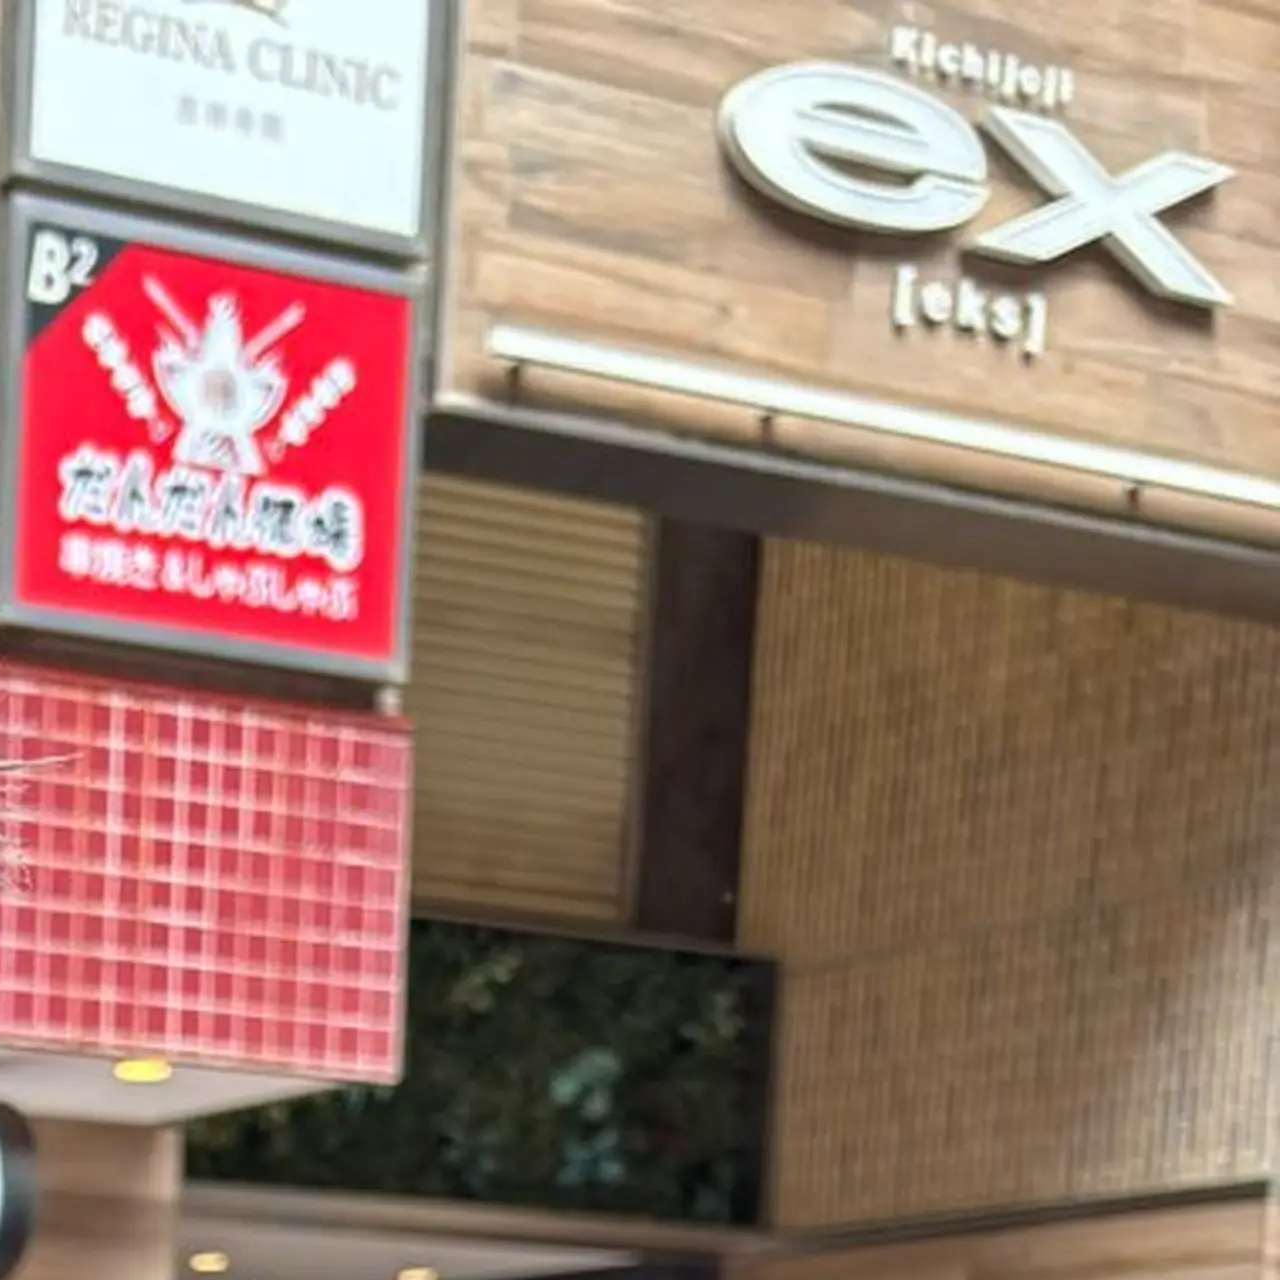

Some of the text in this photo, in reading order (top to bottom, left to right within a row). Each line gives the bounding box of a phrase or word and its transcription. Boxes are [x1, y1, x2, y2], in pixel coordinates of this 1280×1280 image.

[61, 0, 402, 110] REGINA CLINIC
[717, 60, 1238, 310] ex
